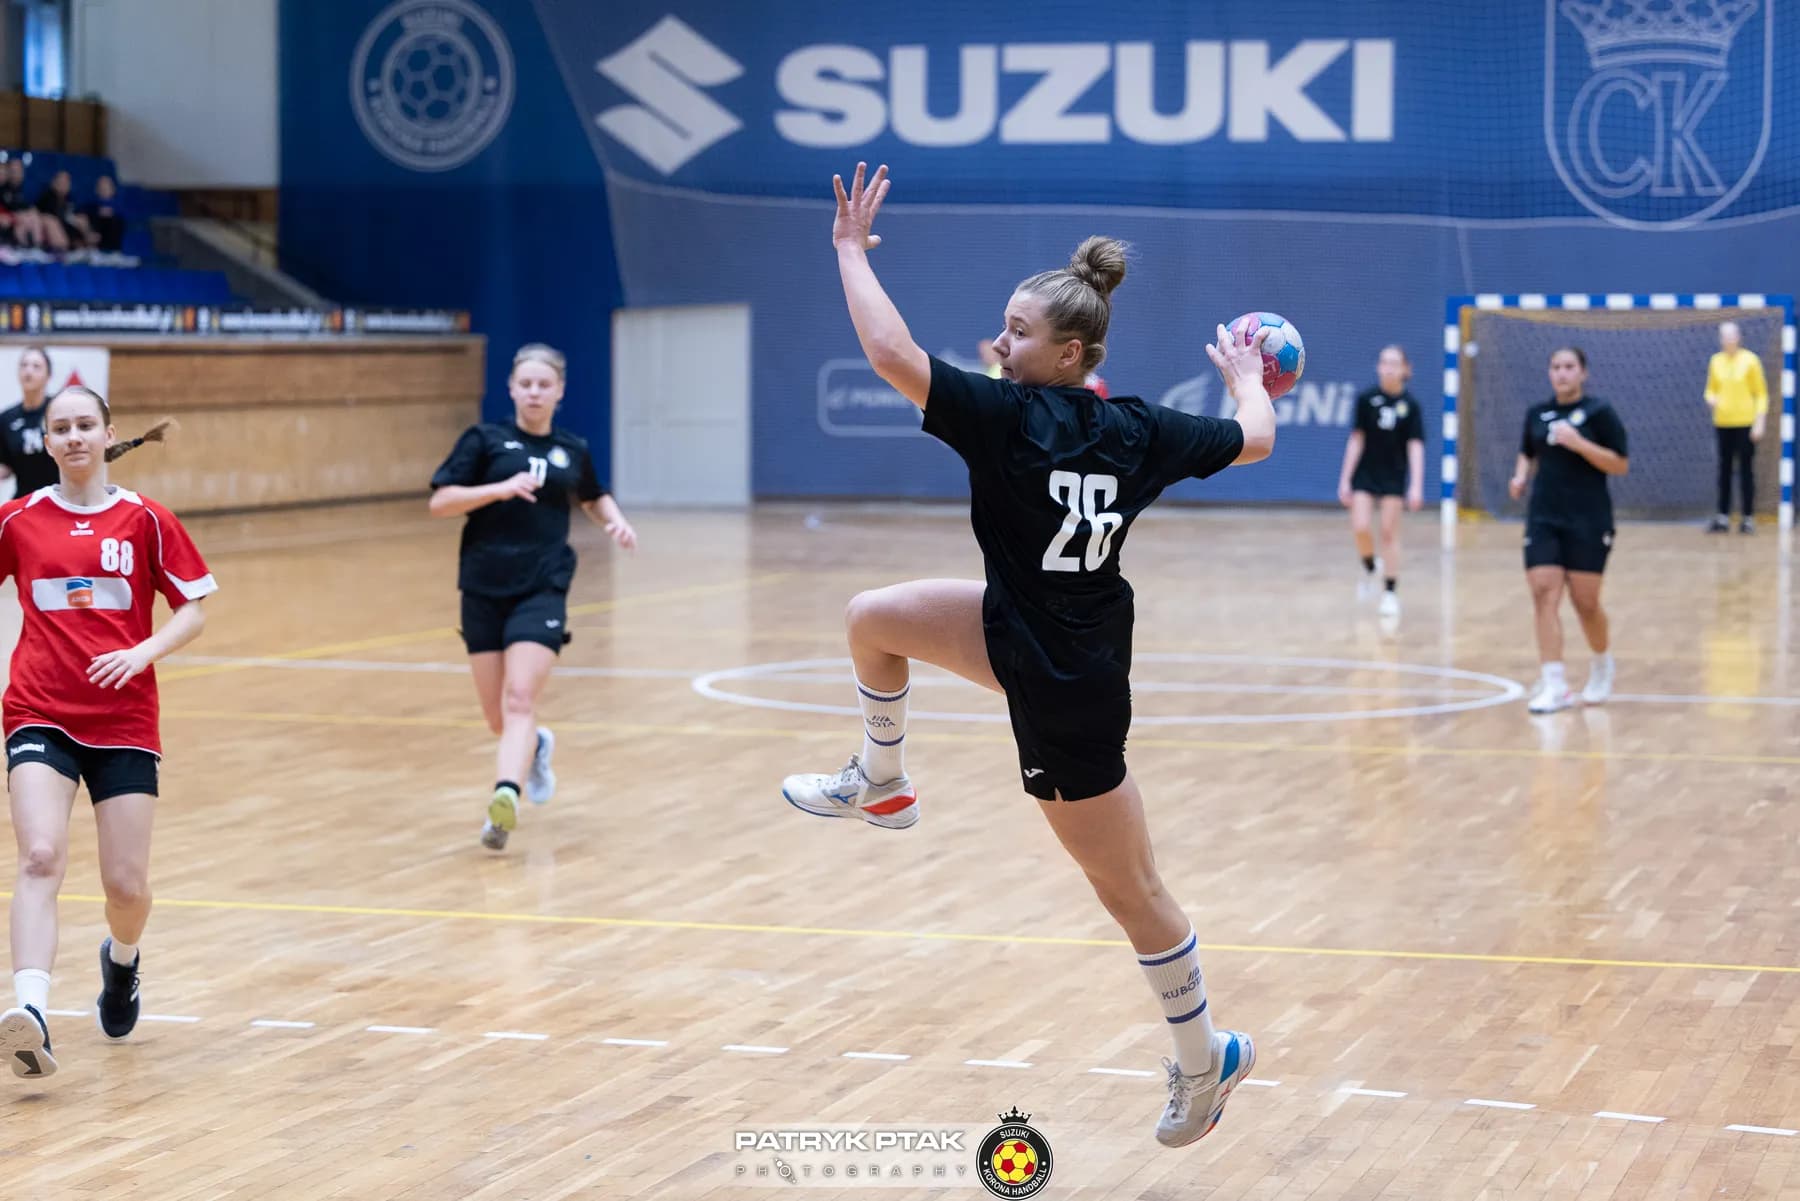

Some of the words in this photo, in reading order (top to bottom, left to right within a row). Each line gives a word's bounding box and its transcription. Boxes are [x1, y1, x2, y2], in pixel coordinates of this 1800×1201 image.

[774, 38, 1395, 148] SUZUKI
[1567, 68, 1730, 199] CK
[100, 537, 134, 577] 88
[1042, 470, 1123, 572] 26
